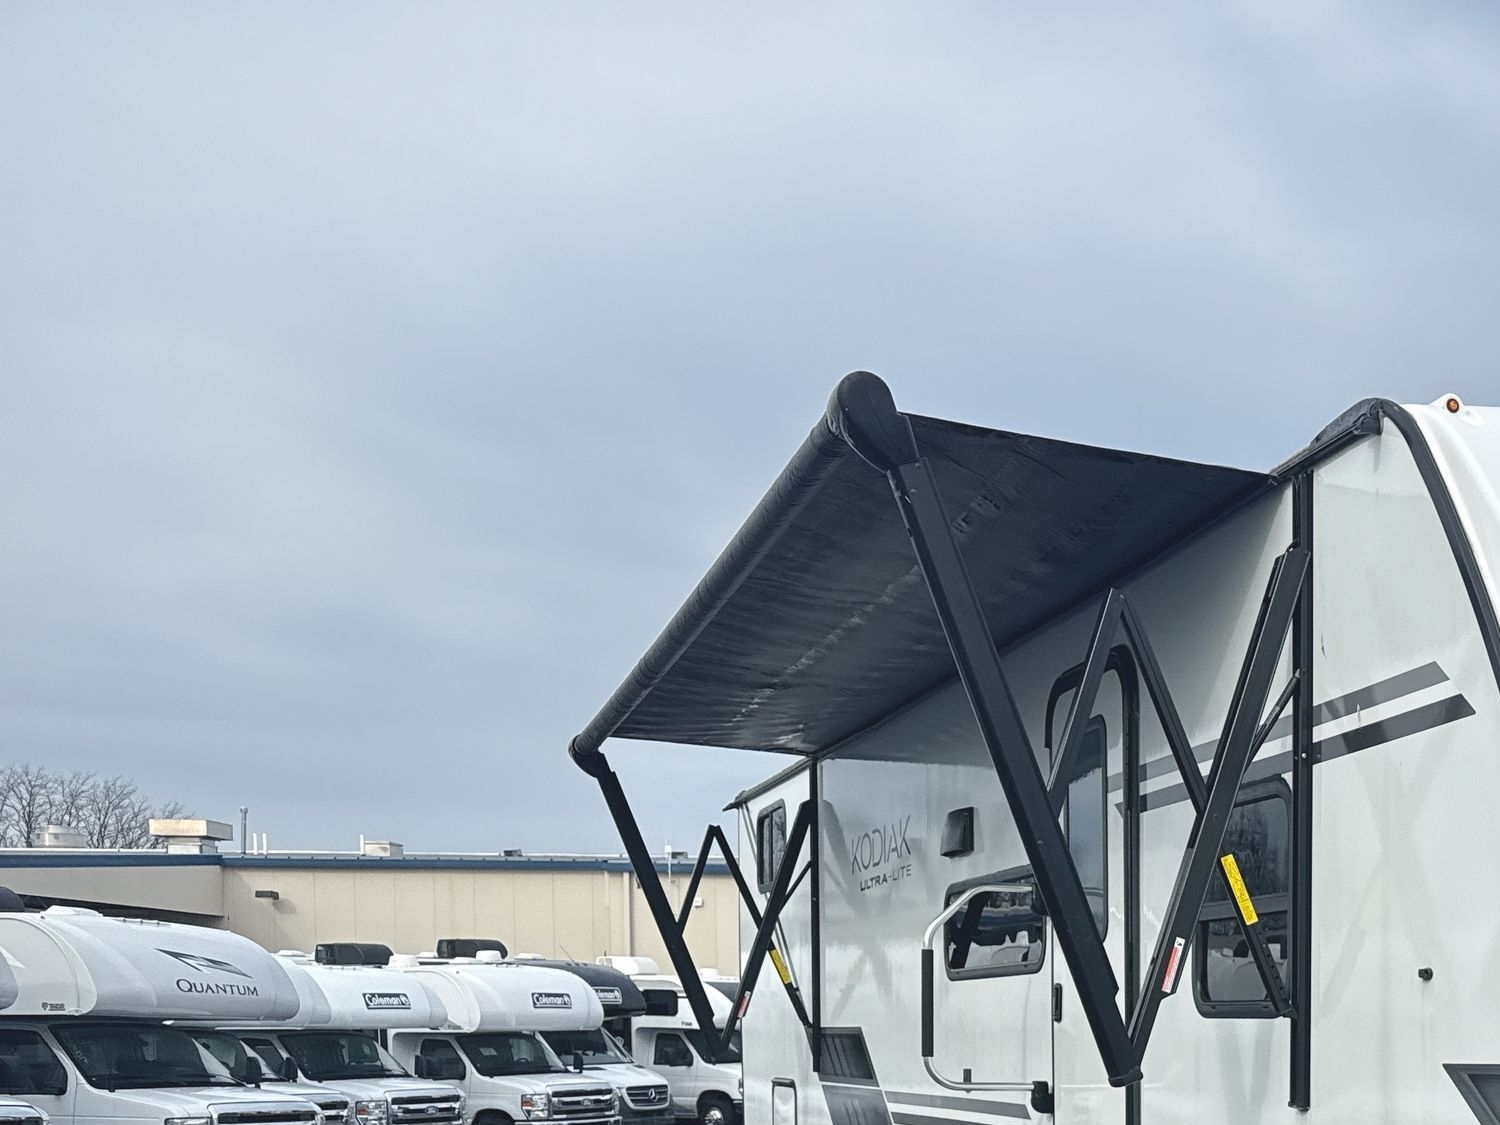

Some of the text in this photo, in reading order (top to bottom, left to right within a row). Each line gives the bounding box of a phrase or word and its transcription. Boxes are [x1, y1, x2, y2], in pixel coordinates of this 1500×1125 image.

[851, 814, 911, 876] KODIAK
[860, 864, 912, 892] ULTRA-LITE
[176, 978, 260, 998] QUANTUM
[365, 994, 402, 1005] Coleman
[533, 993, 565, 1005] Coleman
